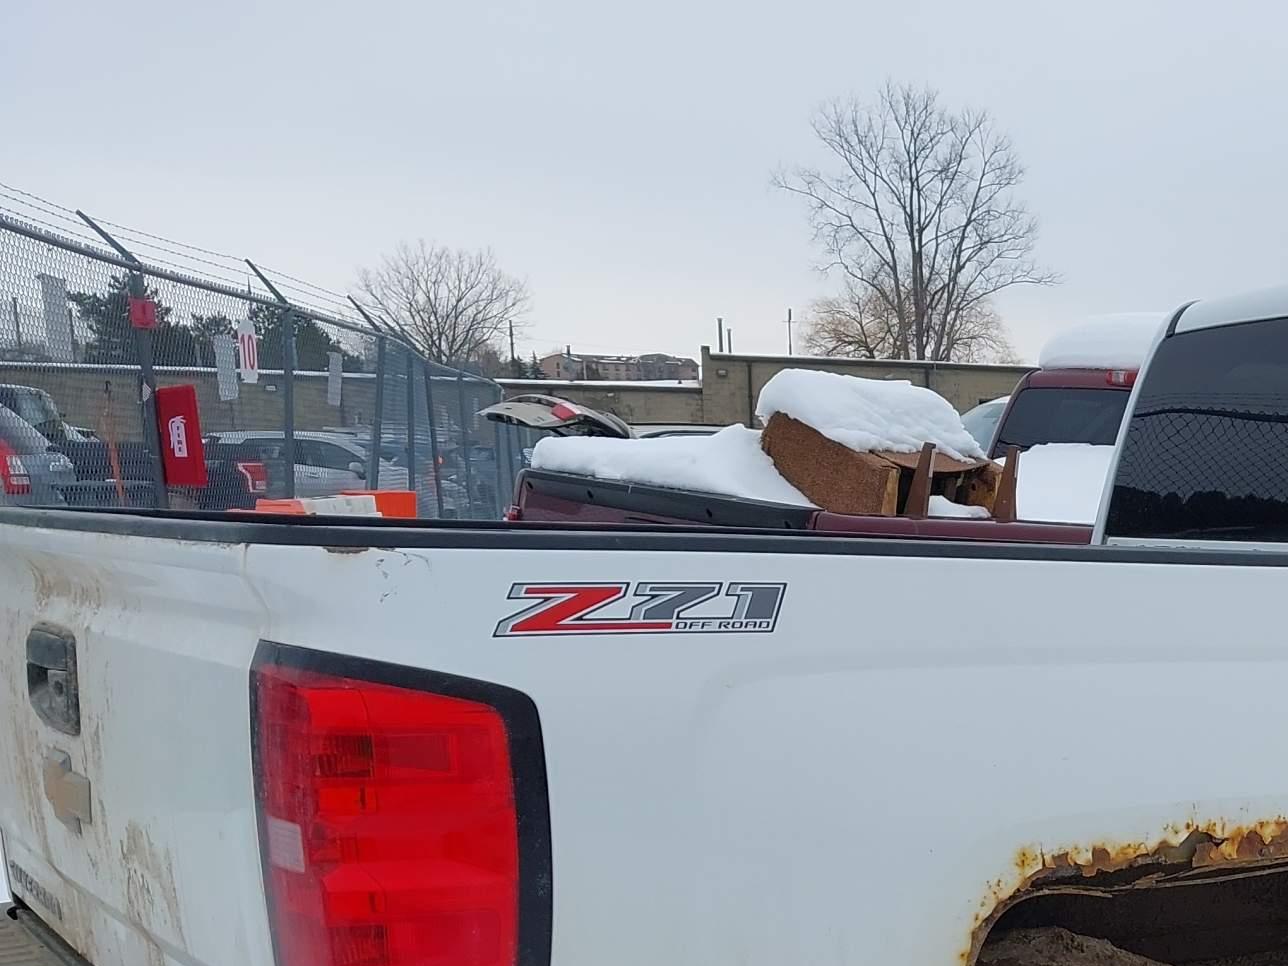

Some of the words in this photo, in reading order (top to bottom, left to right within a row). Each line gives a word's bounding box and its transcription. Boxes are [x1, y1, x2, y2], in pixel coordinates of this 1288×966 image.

[240, 333, 256, 371] 10
[492, 582, 787, 637] Z71
[675, 621, 713, 630] OFF
[718, 620, 771, 630] ROAD
